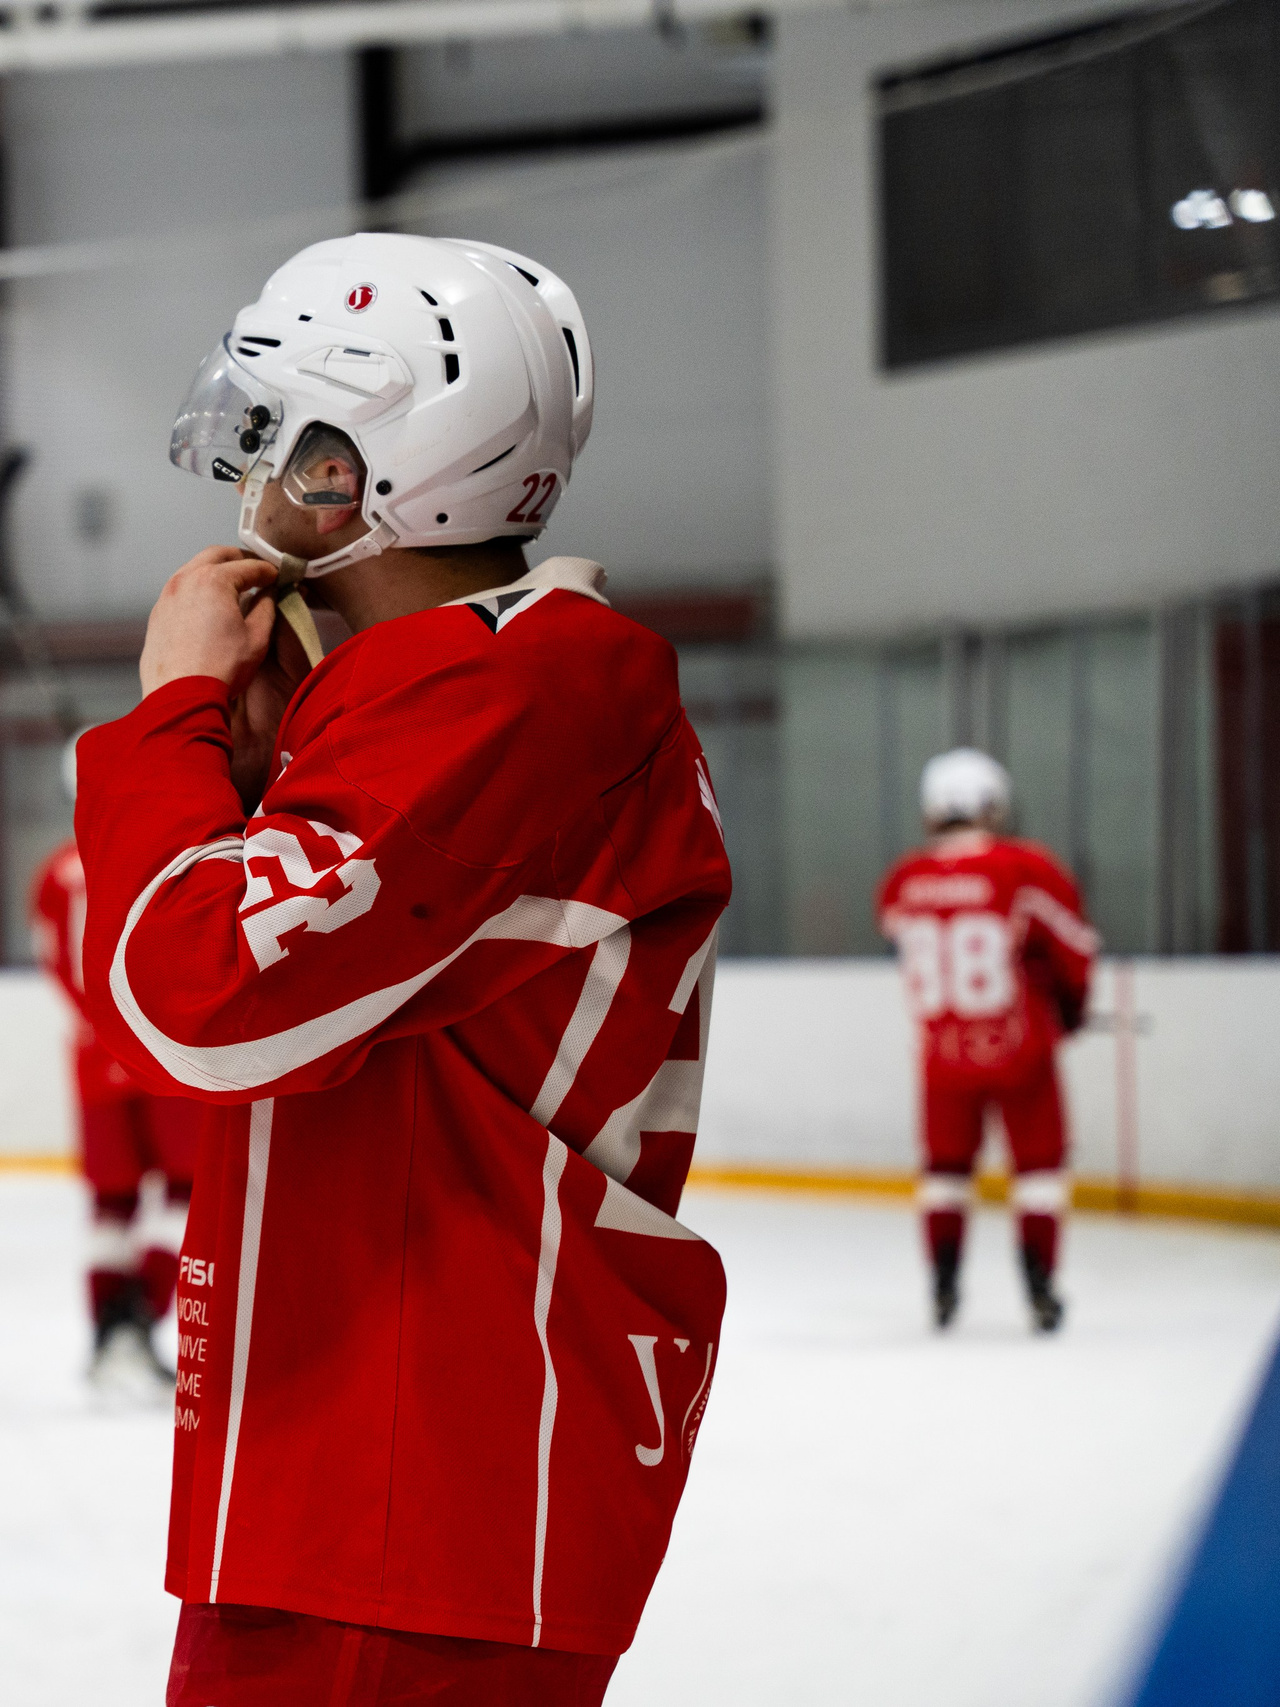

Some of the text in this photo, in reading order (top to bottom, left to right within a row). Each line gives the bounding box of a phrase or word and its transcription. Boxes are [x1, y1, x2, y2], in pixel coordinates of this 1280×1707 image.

[213, 461, 240, 480] CCM
[505, 472, 557, 523] 22
[238, 822, 382, 973] 22
